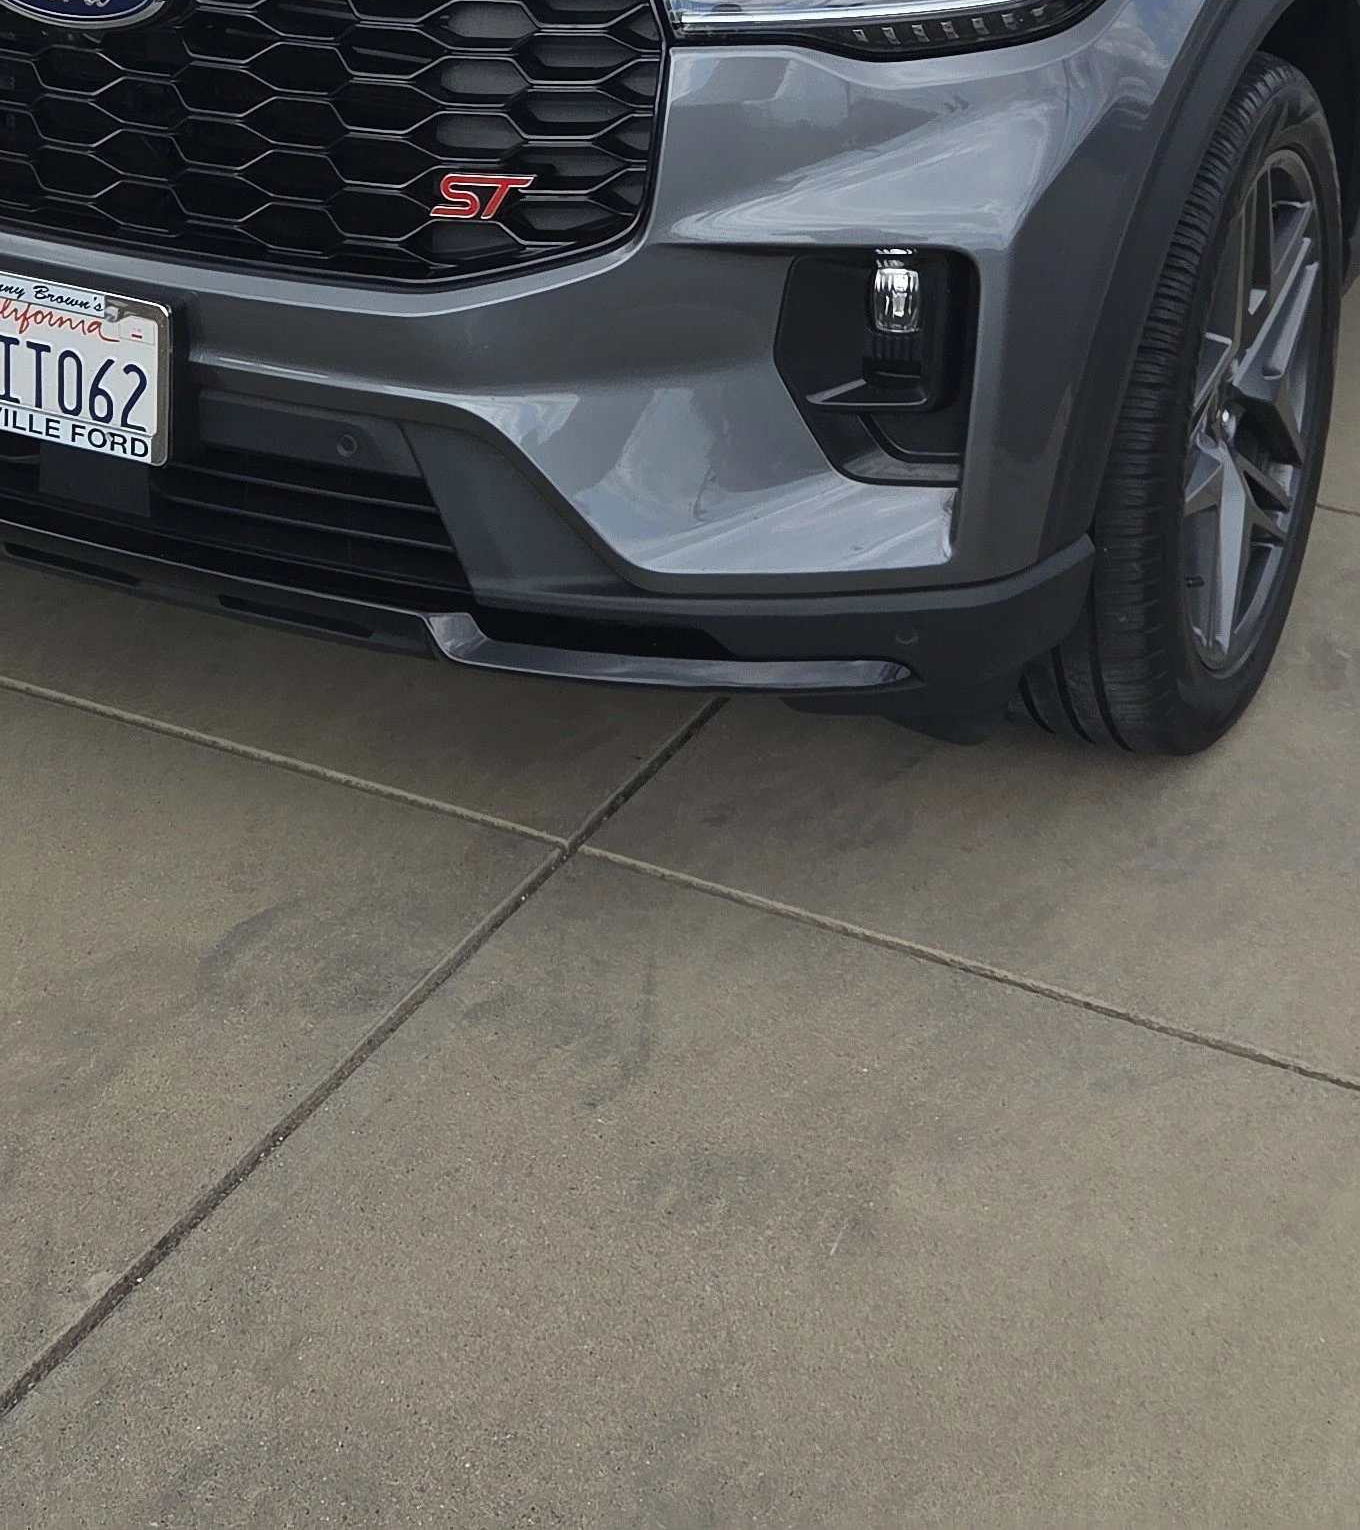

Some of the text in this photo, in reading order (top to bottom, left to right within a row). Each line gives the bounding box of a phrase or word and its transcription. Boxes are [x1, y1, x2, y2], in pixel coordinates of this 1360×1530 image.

[429, 173, 538, 220] ST
[32, 285, 104, 313] Brown's
[71, 424, 149, 458] FORD
